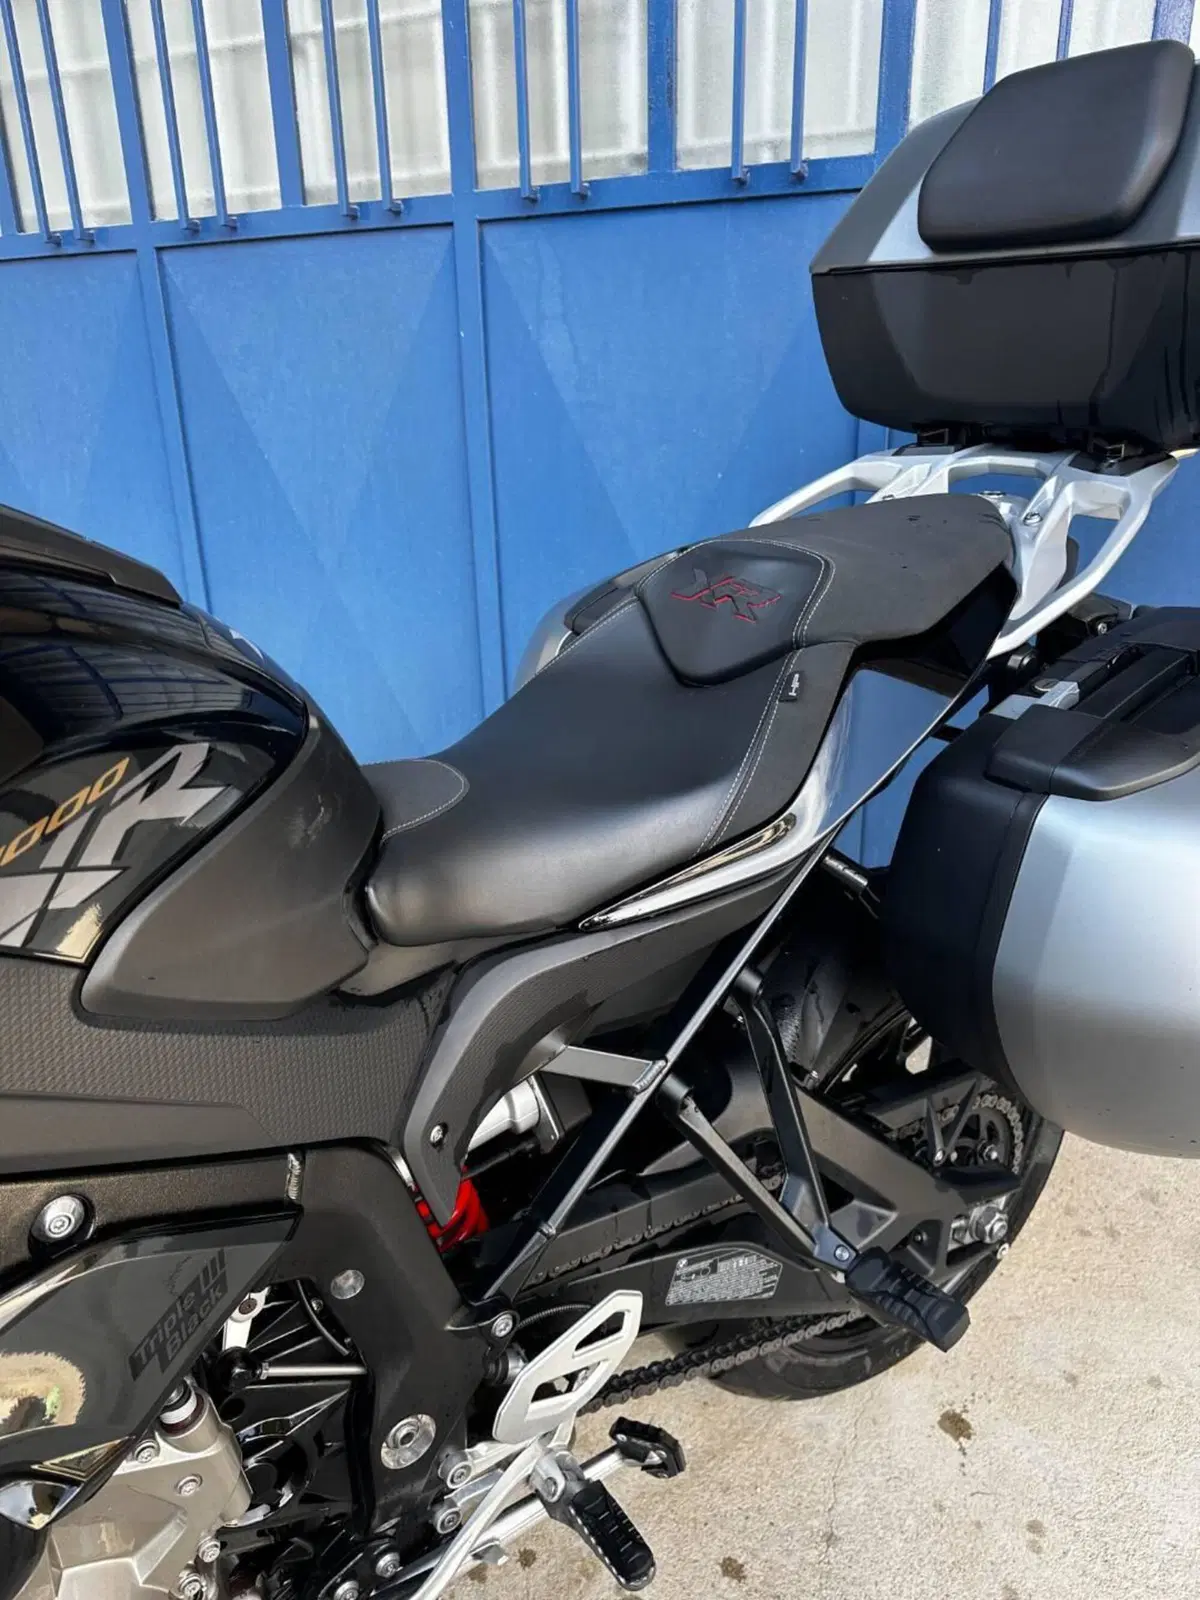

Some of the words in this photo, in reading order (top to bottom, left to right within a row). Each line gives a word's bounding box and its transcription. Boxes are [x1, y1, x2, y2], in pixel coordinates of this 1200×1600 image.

[0, 756, 130, 866] 000
[134, 1291, 196, 1365] Triple
[165, 1283, 222, 1361] Black
